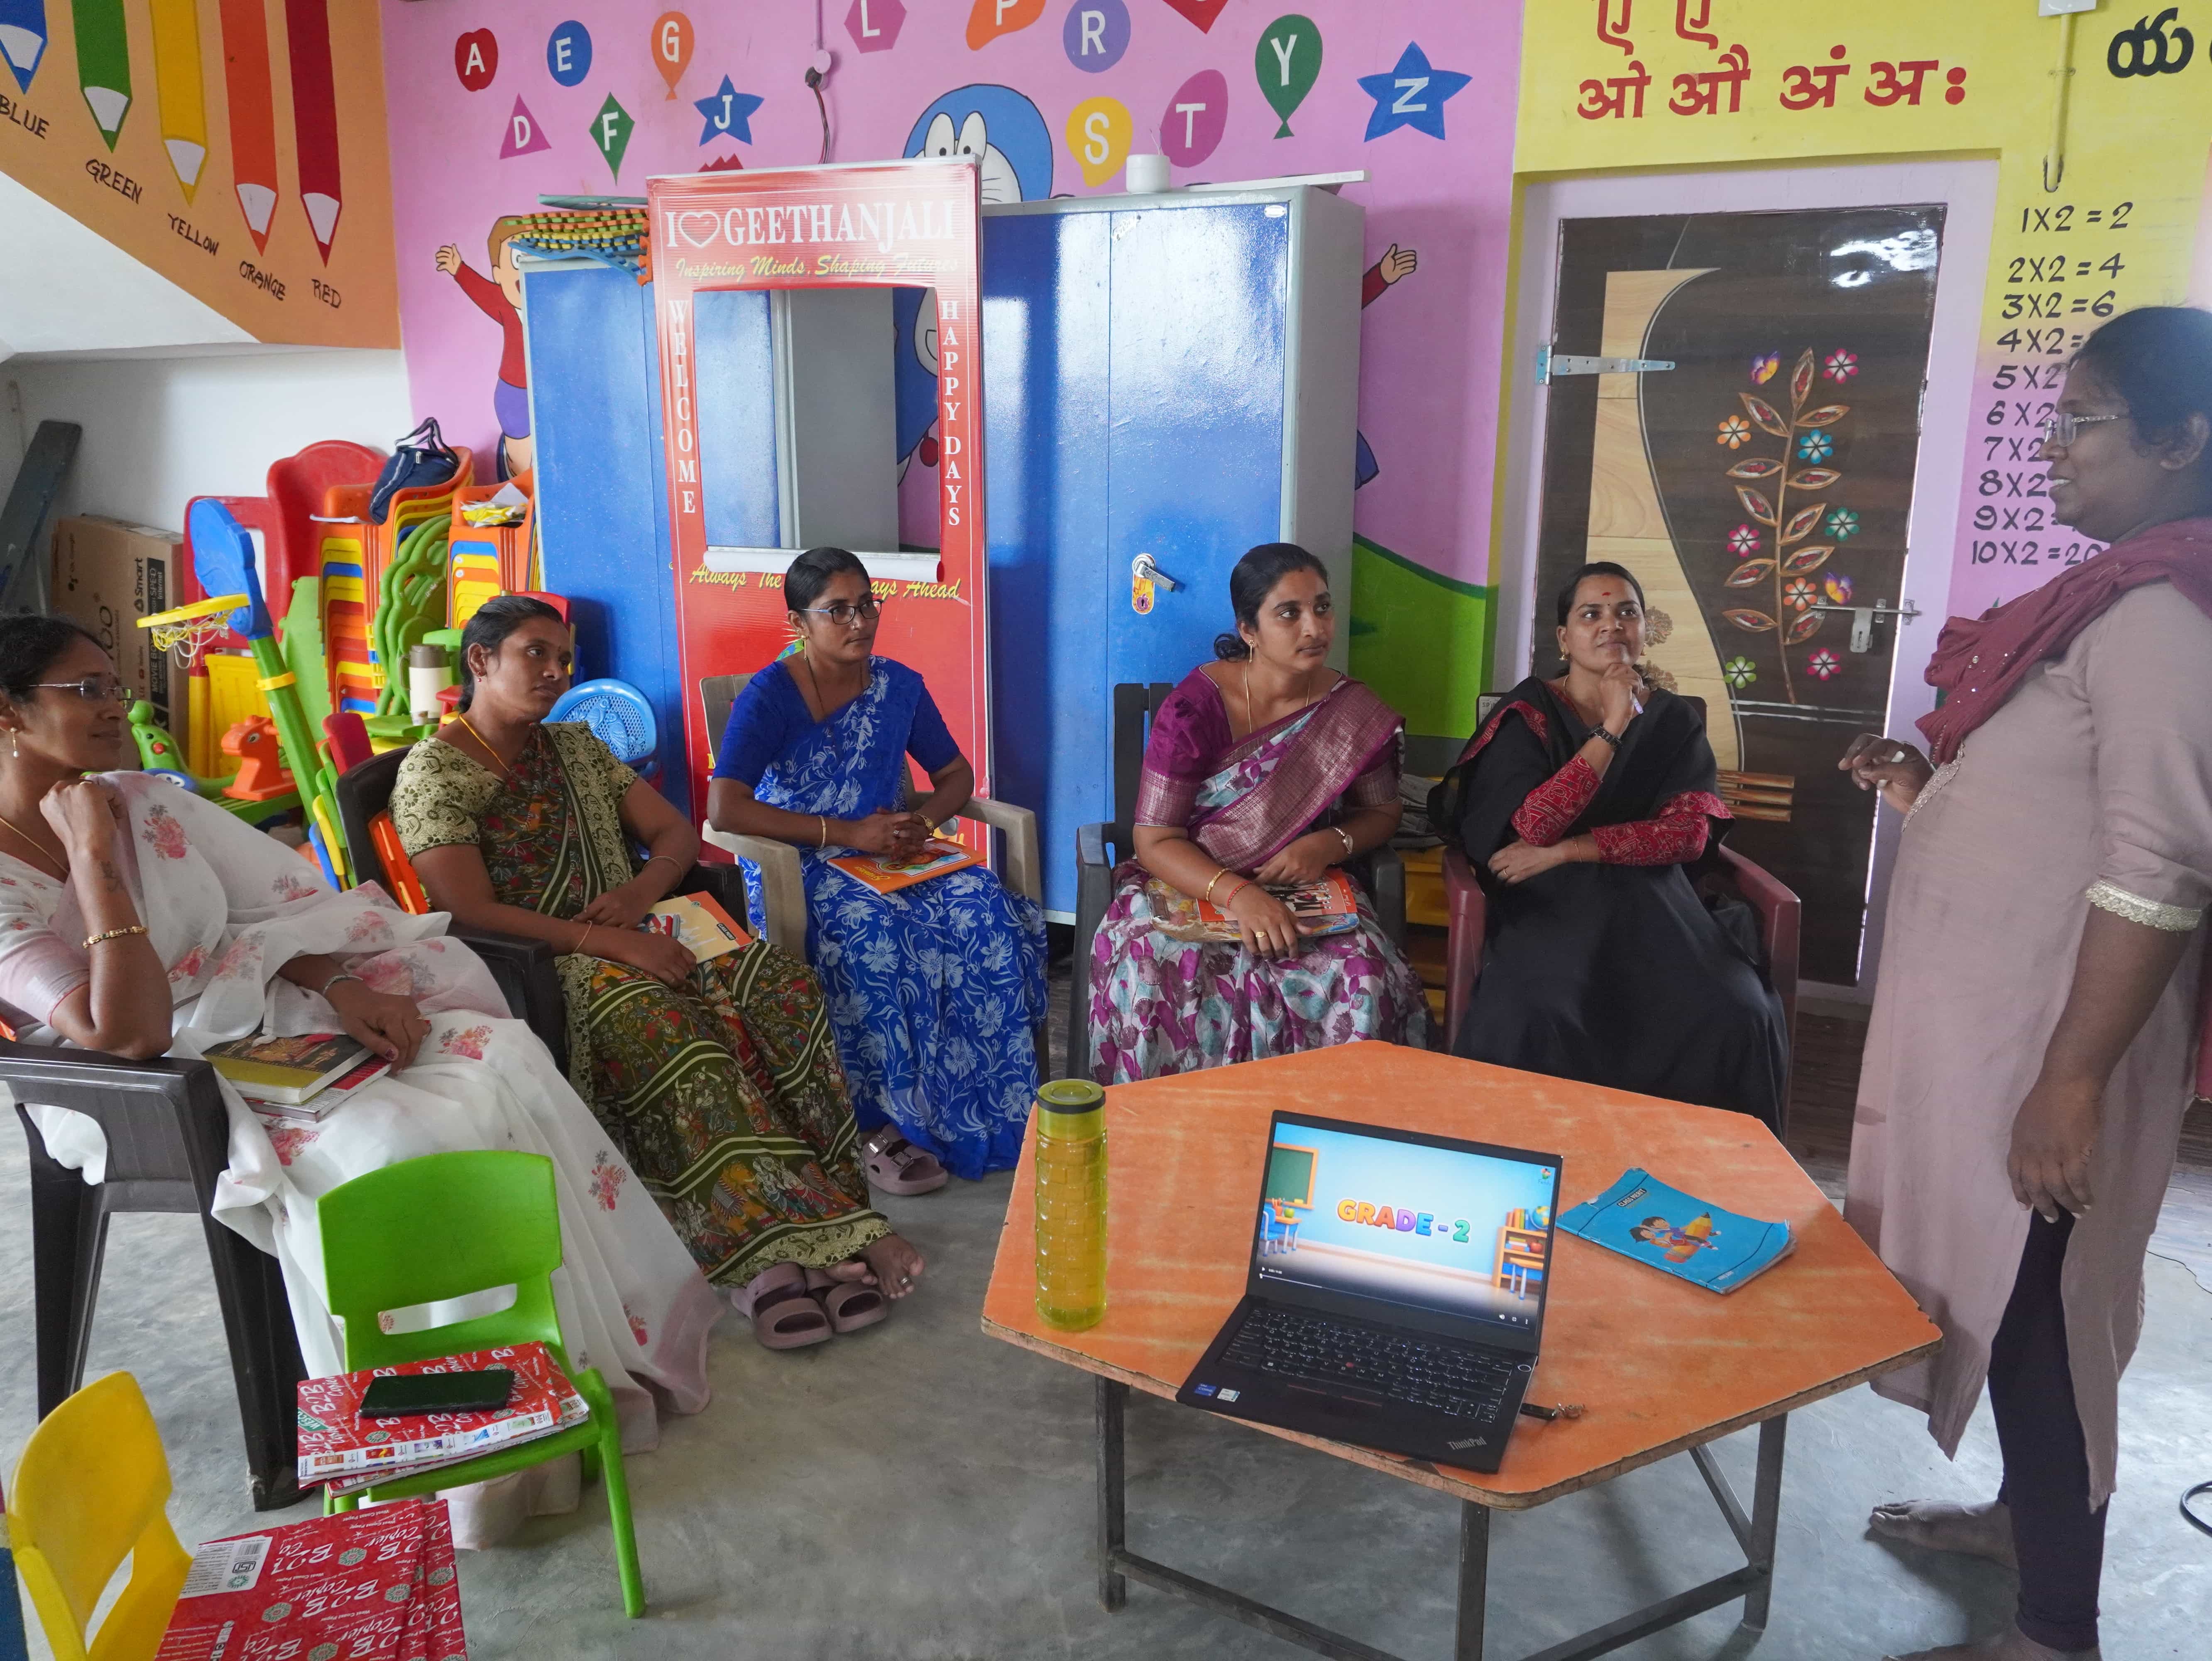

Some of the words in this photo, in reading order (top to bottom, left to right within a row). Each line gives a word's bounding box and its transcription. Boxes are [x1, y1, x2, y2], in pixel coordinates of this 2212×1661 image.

[861, 0, 880, 37] L
[1081, 11, 1106, 56] R
[465, 43, 485, 75] A
[556, 37, 572, 71] E
[662, 21, 679, 63] G
[1270, 34, 1297, 86] Y
[1392, 77, 1430, 114] Z
[1578, 60, 1652, 119] ओ
[1669, 44, 1751, 116] औ
[1779, 44, 1850, 110] अं
[1864, 59, 1966, 106] अः
[0, 94, 49, 140] BLUE
[514, 116, 531, 148] D
[602, 112, 618, 151] F
[714, 95, 732, 130] J
[1176, 103, 1205, 148] T
[1085, 113, 1109, 164] S
[86, 159, 142, 204] GREEN
[167, 213, 219, 256] YELLOW
[666, 212, 678, 247] I
[724, 199, 955, 253] GEETHANJALI
[240, 261, 285, 301] ORANGE
[676, 258, 745, 284] Inspiring
[815, 255, 885, 280] Shaping
[894, 254, 958, 273] Futures
[312, 279, 341, 309] RED
[941, 301, 959, 421] HAPPY
[668, 300, 696, 513] WELCOME
[944, 436, 962, 526] DAYS
[134, 558, 143, 597] Smart
[690, 563, 747, 591] Always
[759, 572, 782, 589] The
[871, 581, 897, 600] ays
[903, 578, 961, 599] Ahead
[718, 924, 727, 932] CLASS
[1618, 1197, 1634, 1207] CLASS
[1630, 1188, 1646, 1199] MERIT
[1338, 1199, 1434, 1236] GRADE
[1453, 1220, 1470, 1243] 2
[300, 1384, 336, 1414] B2B
[1446, 1436, 1487, 1450] ThinkPad
[364, 1526, 418, 1548] Copier
[289, 1579, 347, 1602] Copier
[302, 1579, 379, 1618] B2B
[335, 1617, 395, 1642] Copier
